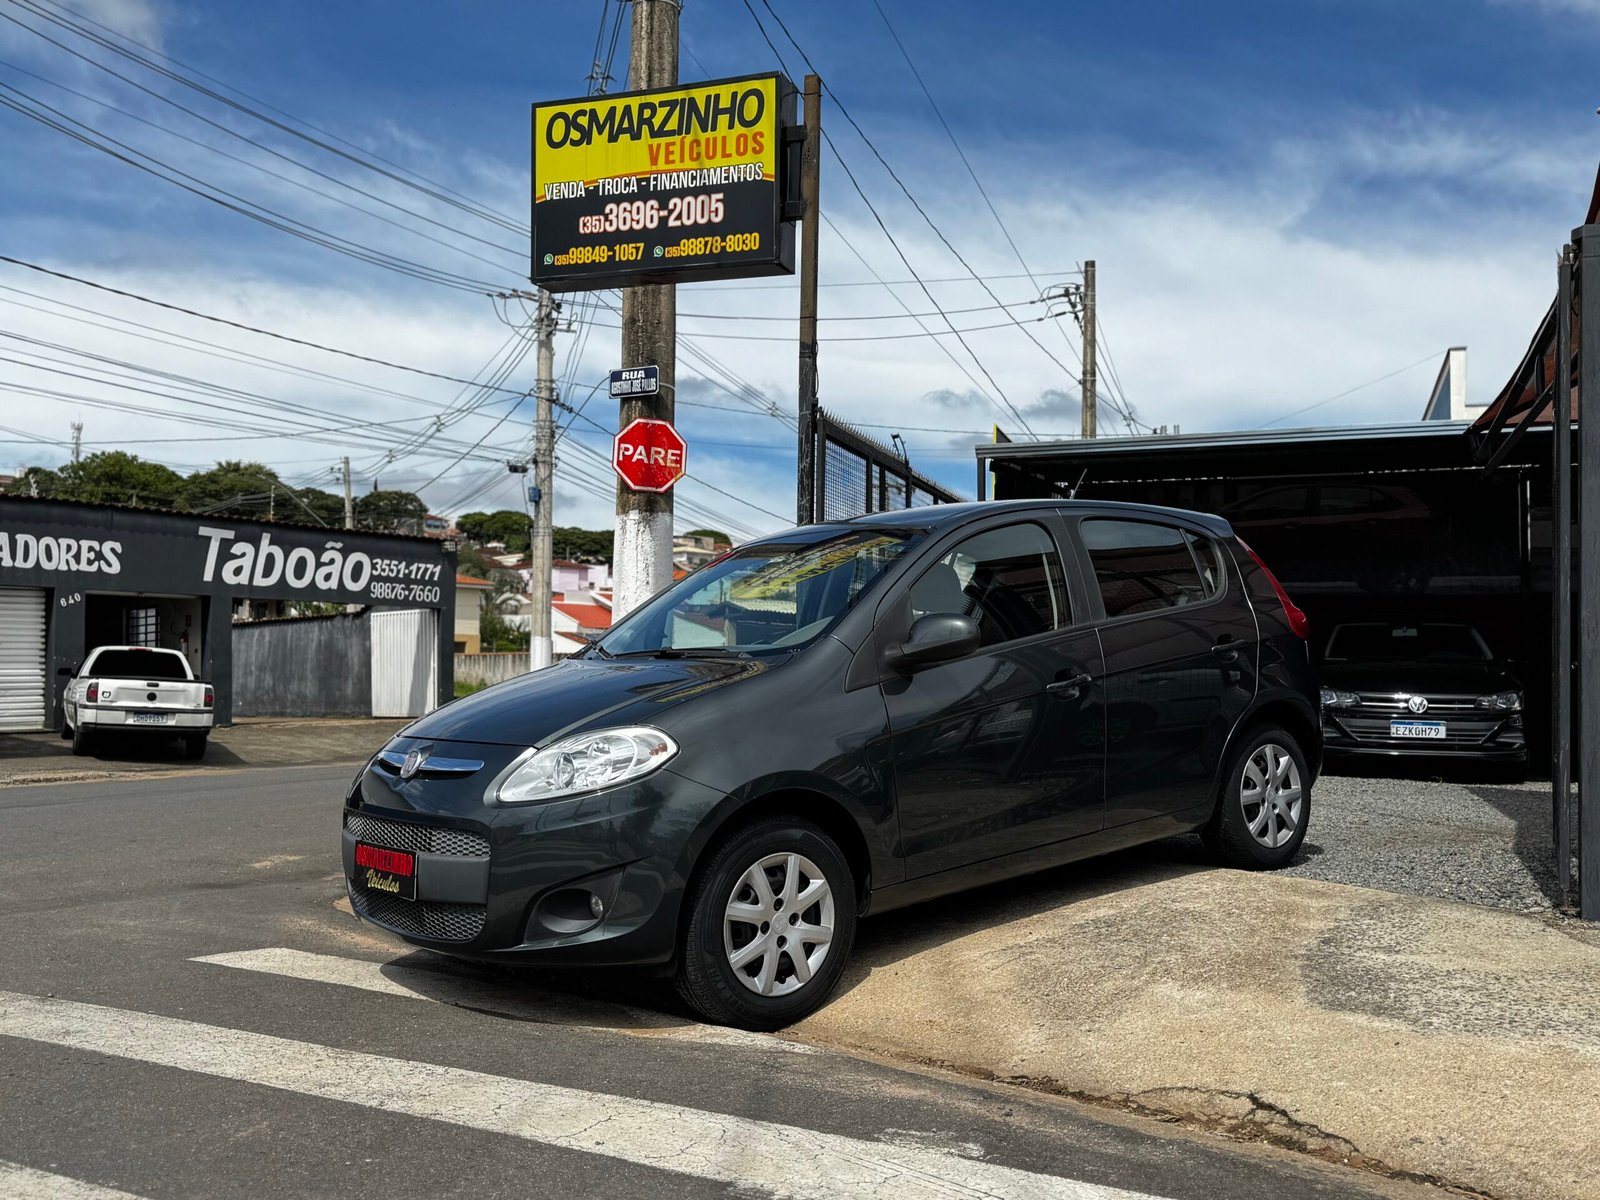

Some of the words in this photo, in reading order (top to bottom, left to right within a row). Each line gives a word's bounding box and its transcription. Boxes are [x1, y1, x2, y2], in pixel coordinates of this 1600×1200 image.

[546, 88, 765, 149] OSMARZINHO
[648, 131, 765, 166] VEÍCULOS
[544, 180, 586, 201] VENDA
[598, 176, 638, 197] TROCA
[650, 162, 764, 192] FINANCIAMENTOS
[622, 370, 645, 380] RUA
[619, 443, 681, 468] PARE
[0, 532, 122, 574] ADORES
[198, 526, 372, 592] Taboão
